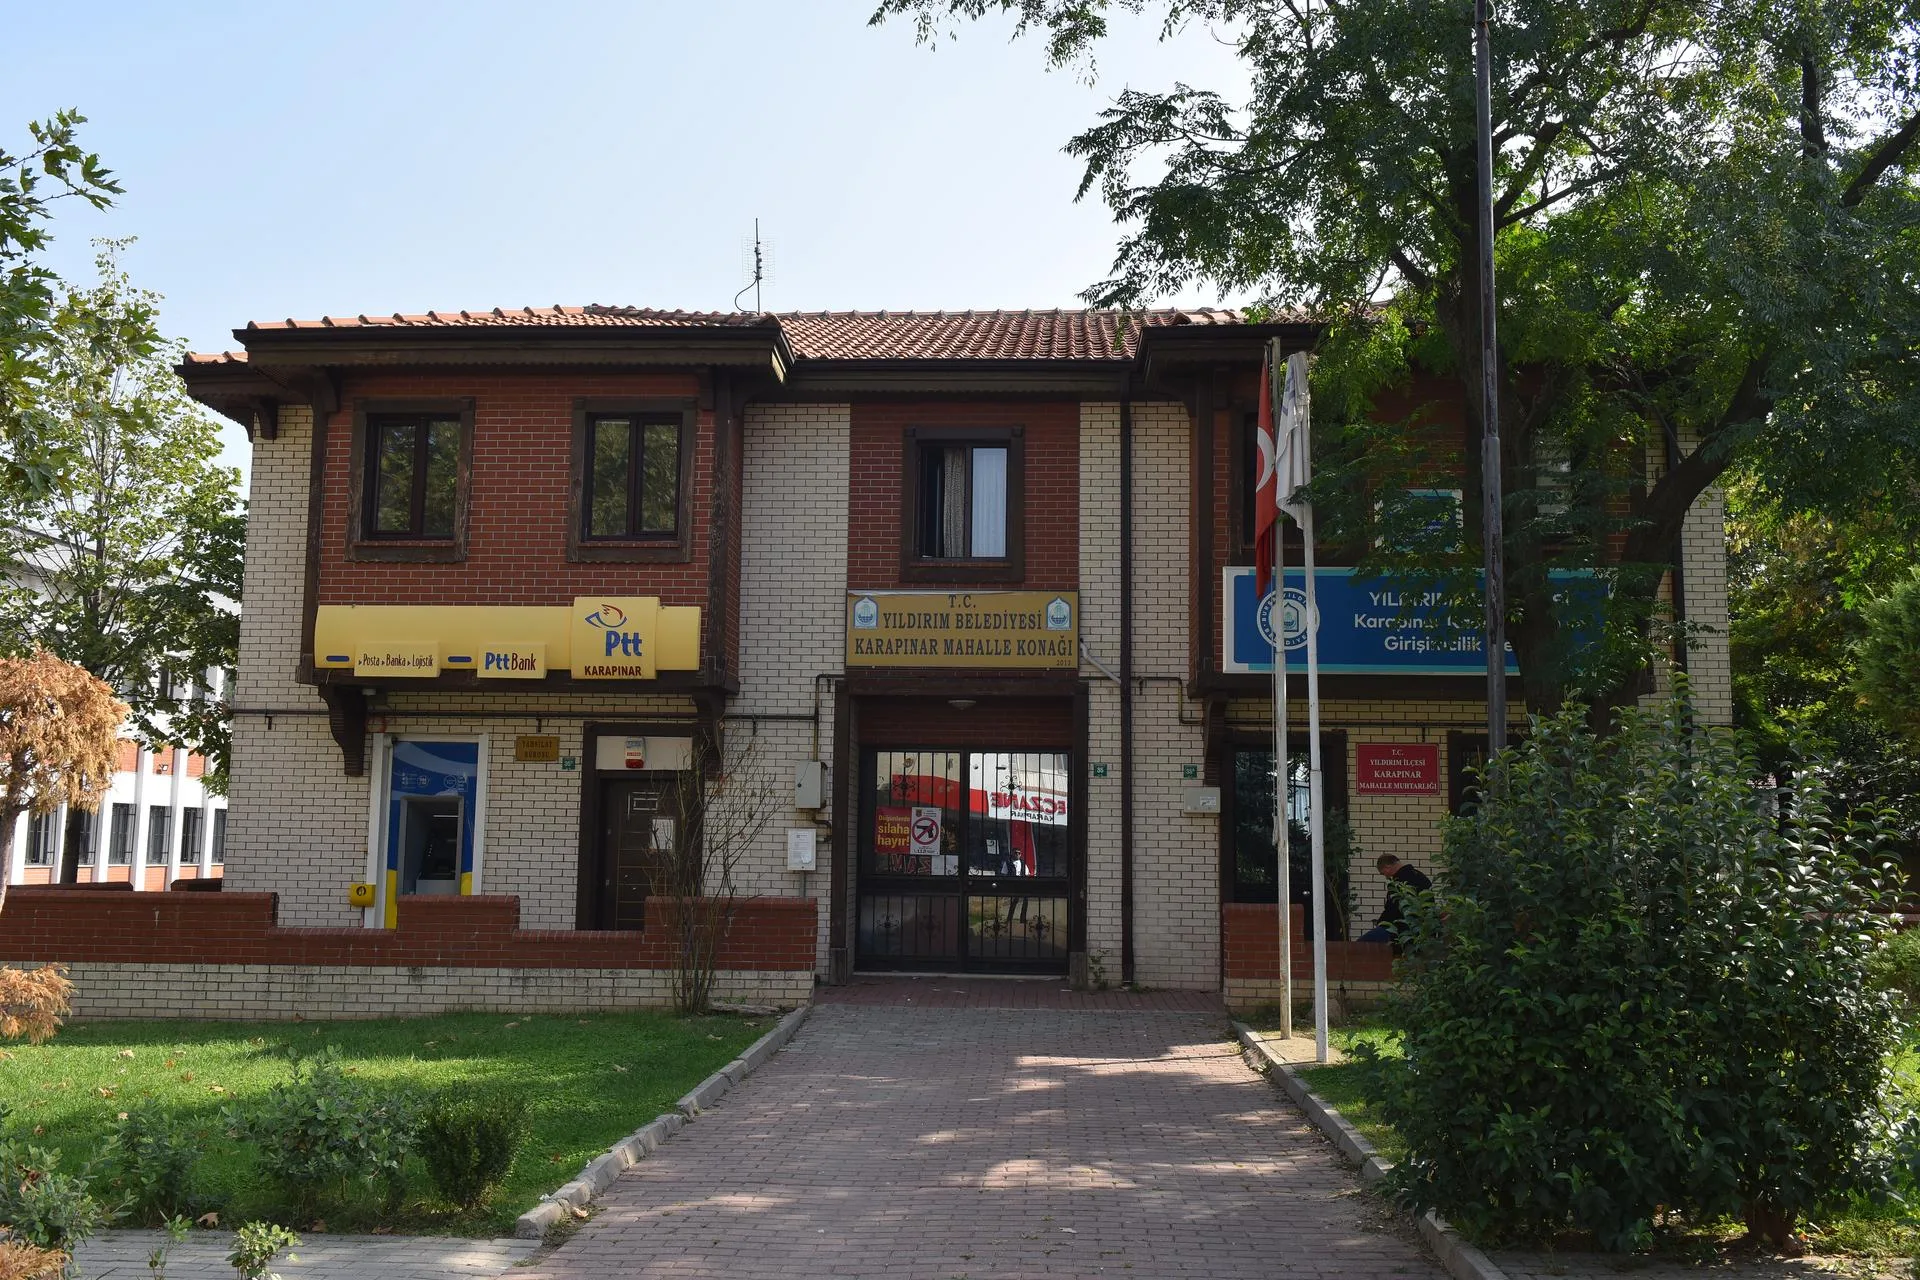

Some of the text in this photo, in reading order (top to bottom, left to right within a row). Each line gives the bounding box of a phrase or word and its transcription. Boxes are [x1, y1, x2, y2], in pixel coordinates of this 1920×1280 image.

[949, 595, 976, 609] T.C.
[883, 610, 1042, 630] YILDIRIM BELEDİYESİ
[1354, 614, 1438, 632] Karapın
[605, 630, 643, 657] Ptt
[855, 635, 1073, 656] KARAPINAR MAHALLE KONAĞI
[363, 653, 433, 669] Posta Banka Lojistik
[584, 665, 642, 676] KARAPINAR
[1374, 770, 1421, 778] KARAPINAR
[1393, 782, 1437, 790] MUHTARLIĞI
[878, 823, 910, 834] silaha
[877, 834, 910, 848] hayır!
